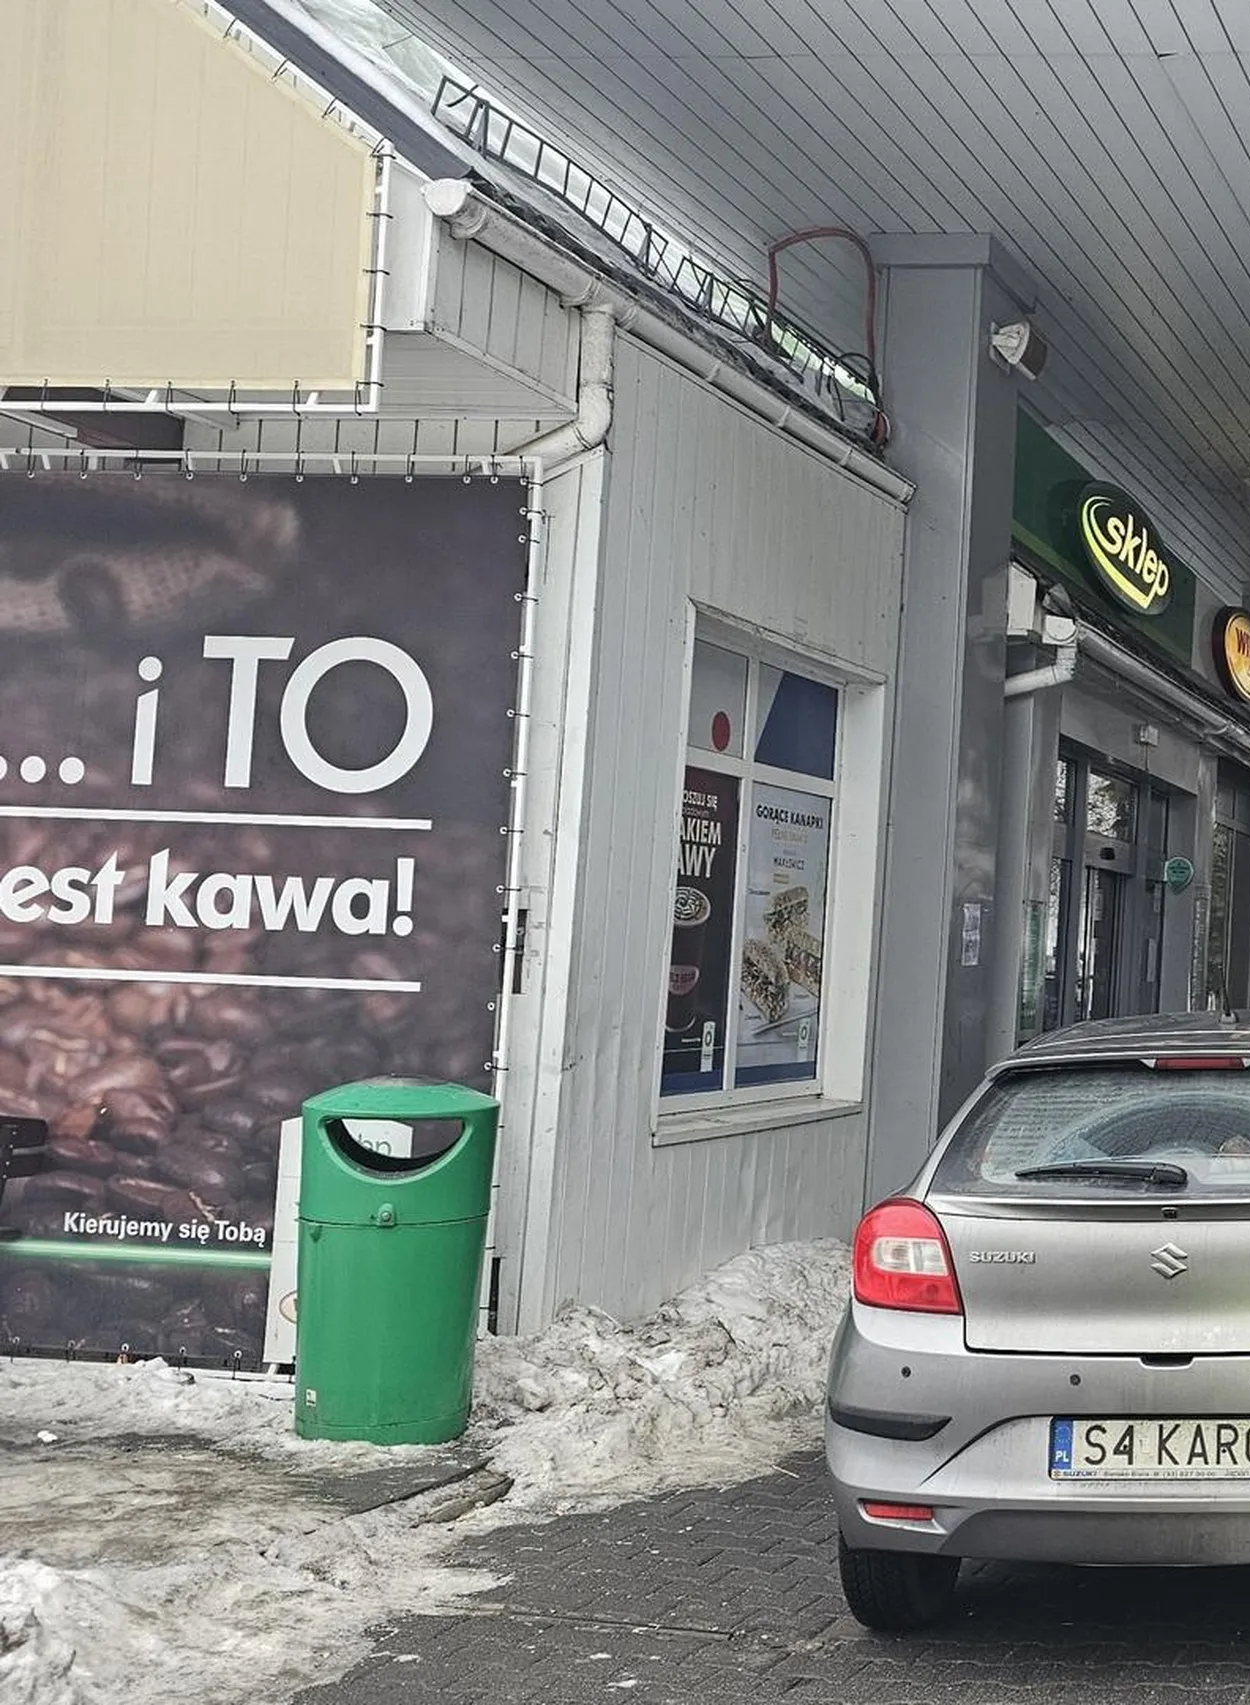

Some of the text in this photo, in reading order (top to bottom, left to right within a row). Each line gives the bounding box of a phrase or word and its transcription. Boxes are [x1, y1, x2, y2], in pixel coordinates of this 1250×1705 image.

[1107, 513, 1170, 602] sklep
[131, 656, 164, 786] i
[203, 635, 433, 794] TO
[756, 804, 789, 825] GORĄCE
[145, 848, 416, 937] kawa!
[64, 1212, 267, 1248] Kierujemy się Tobą
[969, 1251, 1036, 1265] SUZUKI
[1055, 1451, 1070, 1462] PL
[1084, 1424, 1135, 1466] S4
